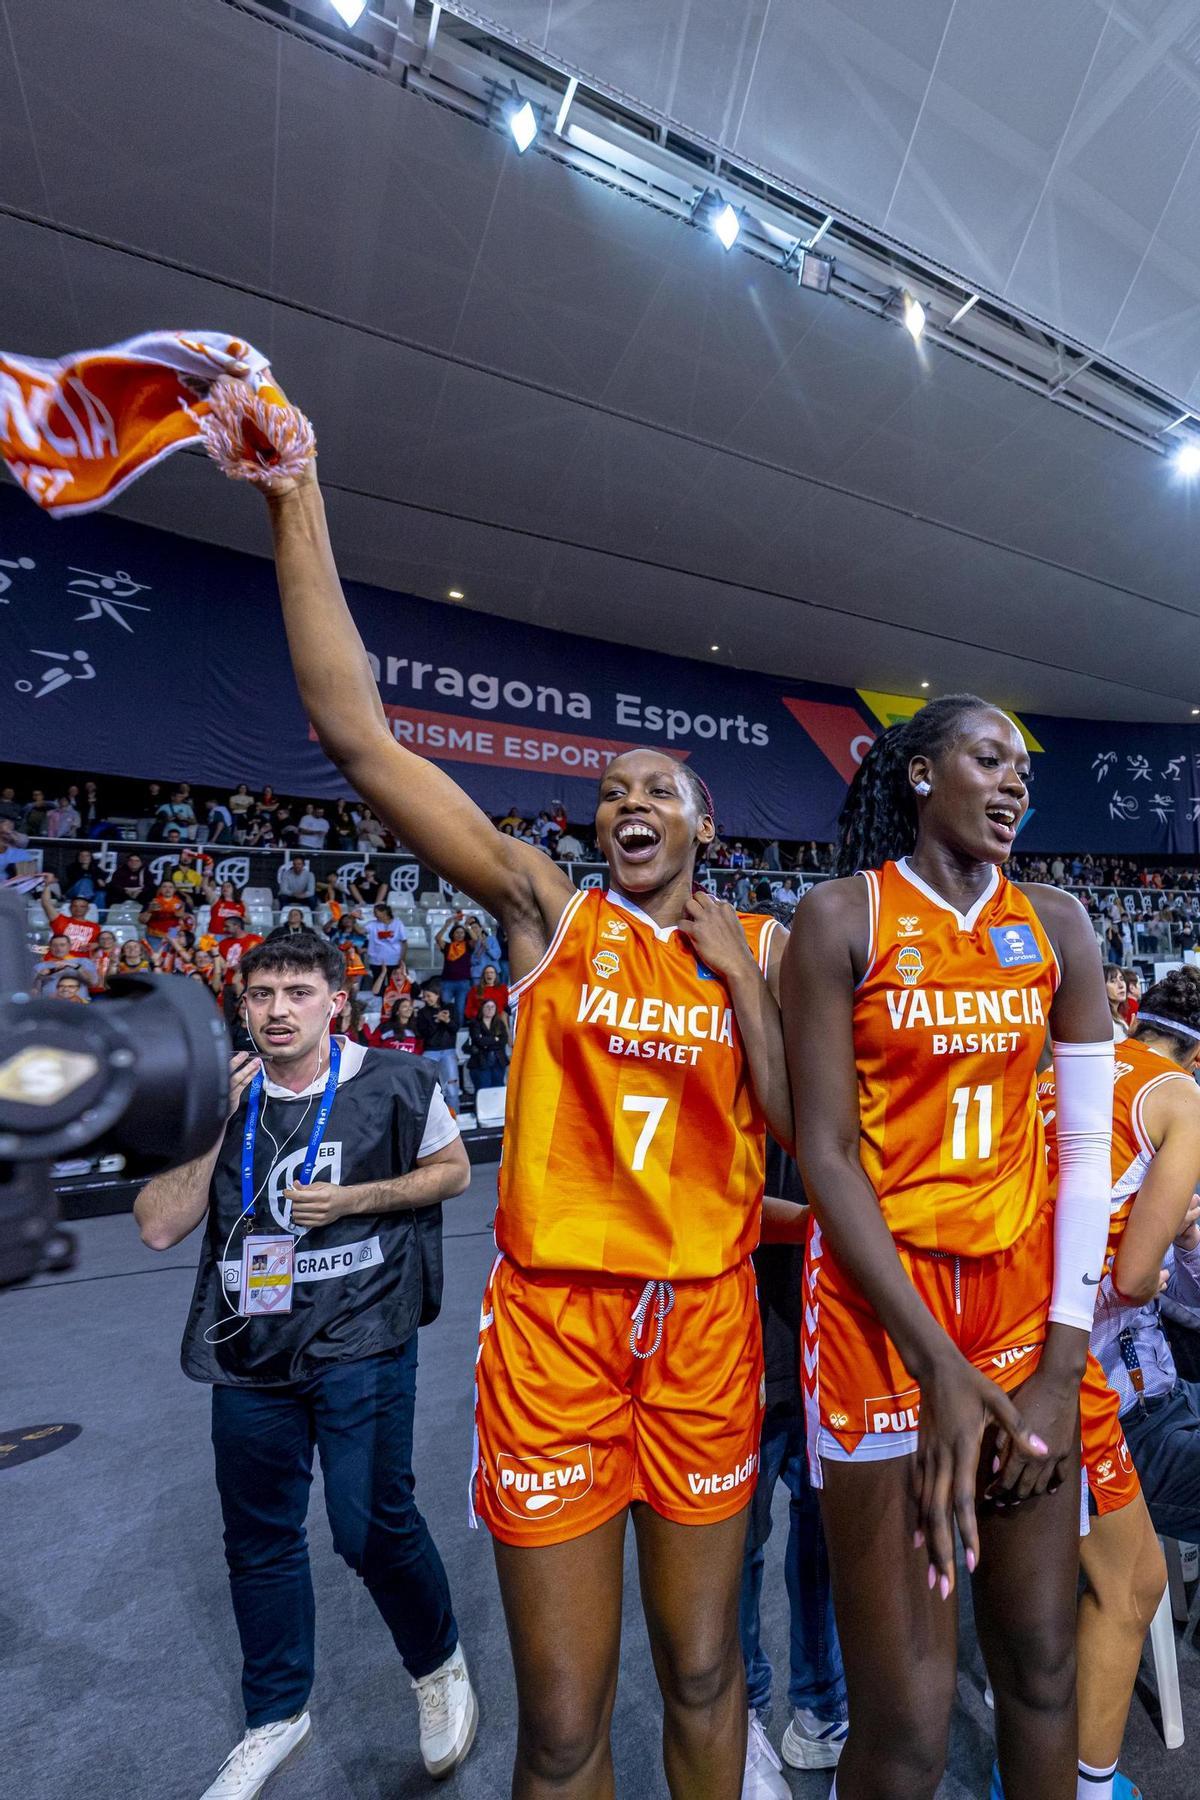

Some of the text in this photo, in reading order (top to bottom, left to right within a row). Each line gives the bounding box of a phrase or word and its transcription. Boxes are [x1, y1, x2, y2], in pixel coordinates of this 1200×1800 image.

[366, 650, 770, 747] rragona Esports
[387, 717, 494, 755] RISME
[576, 983, 734, 1048] VALENCIA
[886, 988, 1045, 1030] VALENCIA
[608, 1034, 703, 1066] BASKET
[932, 1031, 1021, 1055] BASKET
[622, 1094, 670, 1172] 7
[951, 1084, 993, 1160] 11
[319, 1147, 335, 1157] EB
[297, 1251, 353, 1274] GRAFO
[873, 1405, 920, 1433] PUL
[501, 1464, 586, 1492] PULEVA
